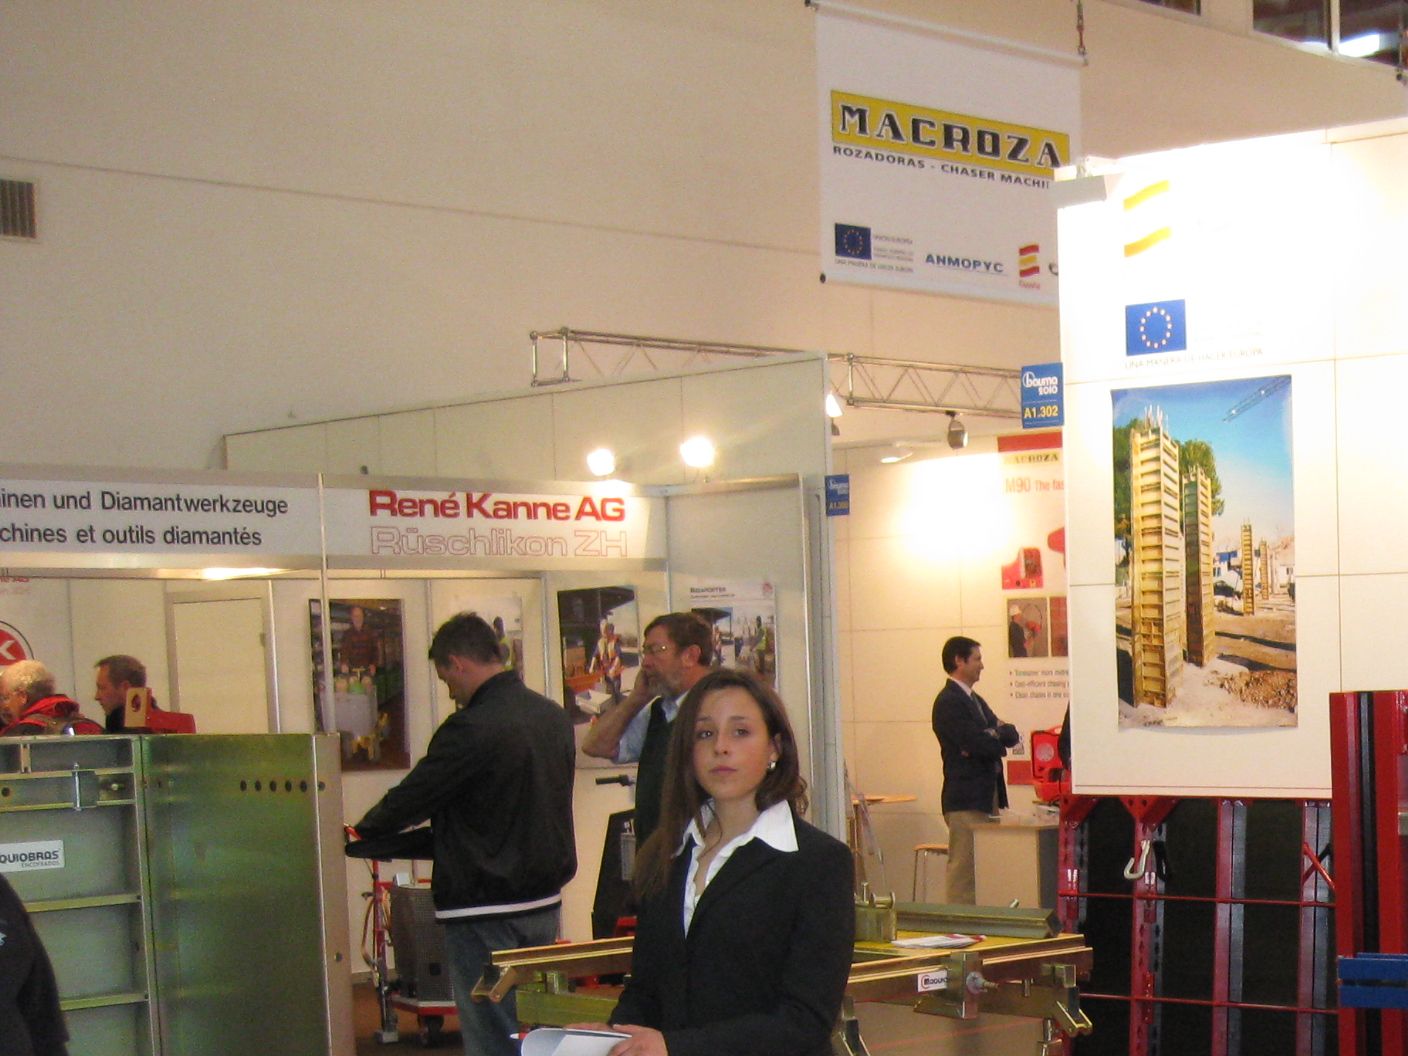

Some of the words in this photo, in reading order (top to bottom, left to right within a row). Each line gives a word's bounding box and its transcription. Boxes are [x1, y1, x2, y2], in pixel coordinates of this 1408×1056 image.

[841, 104, 1062, 168] MACROZA
[833, 145, 925, 169] ROZADORAS
[941, 164, 996, 181] CHASER
[925, 254, 1005, 273] ANMOPYC
[1024, 405, 1058, 418] A1.302
[53, 491, 91, 510] und
[101, 491, 289, 517] Diamantwerkzeuge
[368, 489, 460, 518] René
[466, 492, 571, 521] Kanne
[575, 496, 625, 521] AG
[77, 526, 96, 544] et
[103, 525, 155, 545] outils
[163, 526, 262, 546] diamantés
[370, 526, 567, 557] Rüschlikon
[574, 530, 628, 557] ZH
